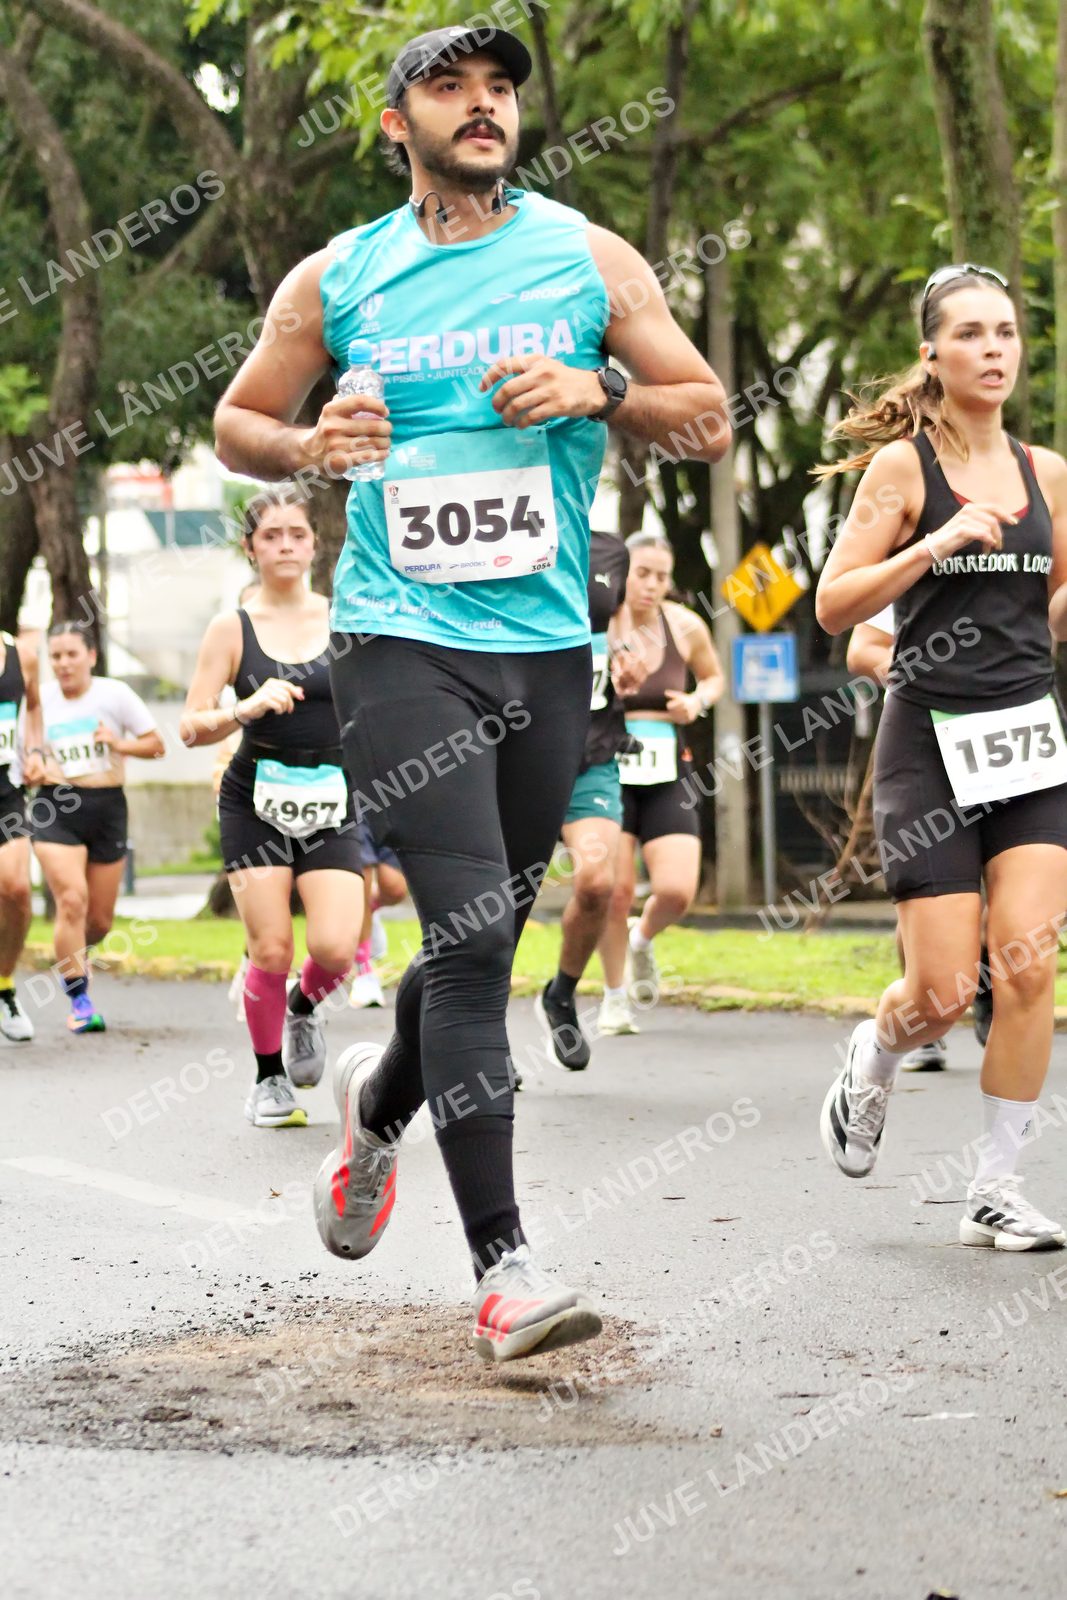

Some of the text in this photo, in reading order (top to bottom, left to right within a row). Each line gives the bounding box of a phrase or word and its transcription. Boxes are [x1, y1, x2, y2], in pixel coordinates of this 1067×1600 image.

[519, 286, 580, 302] BROOKS
[400, 495, 545, 550] 3054
[404, 563, 441, 573] PERDURA
[531, 561, 551, 572] 3054
[932, 553, 1018, 576] CORREDOR
[955, 722, 1057, 774] 1573
[263, 798, 339, 826] 4967
